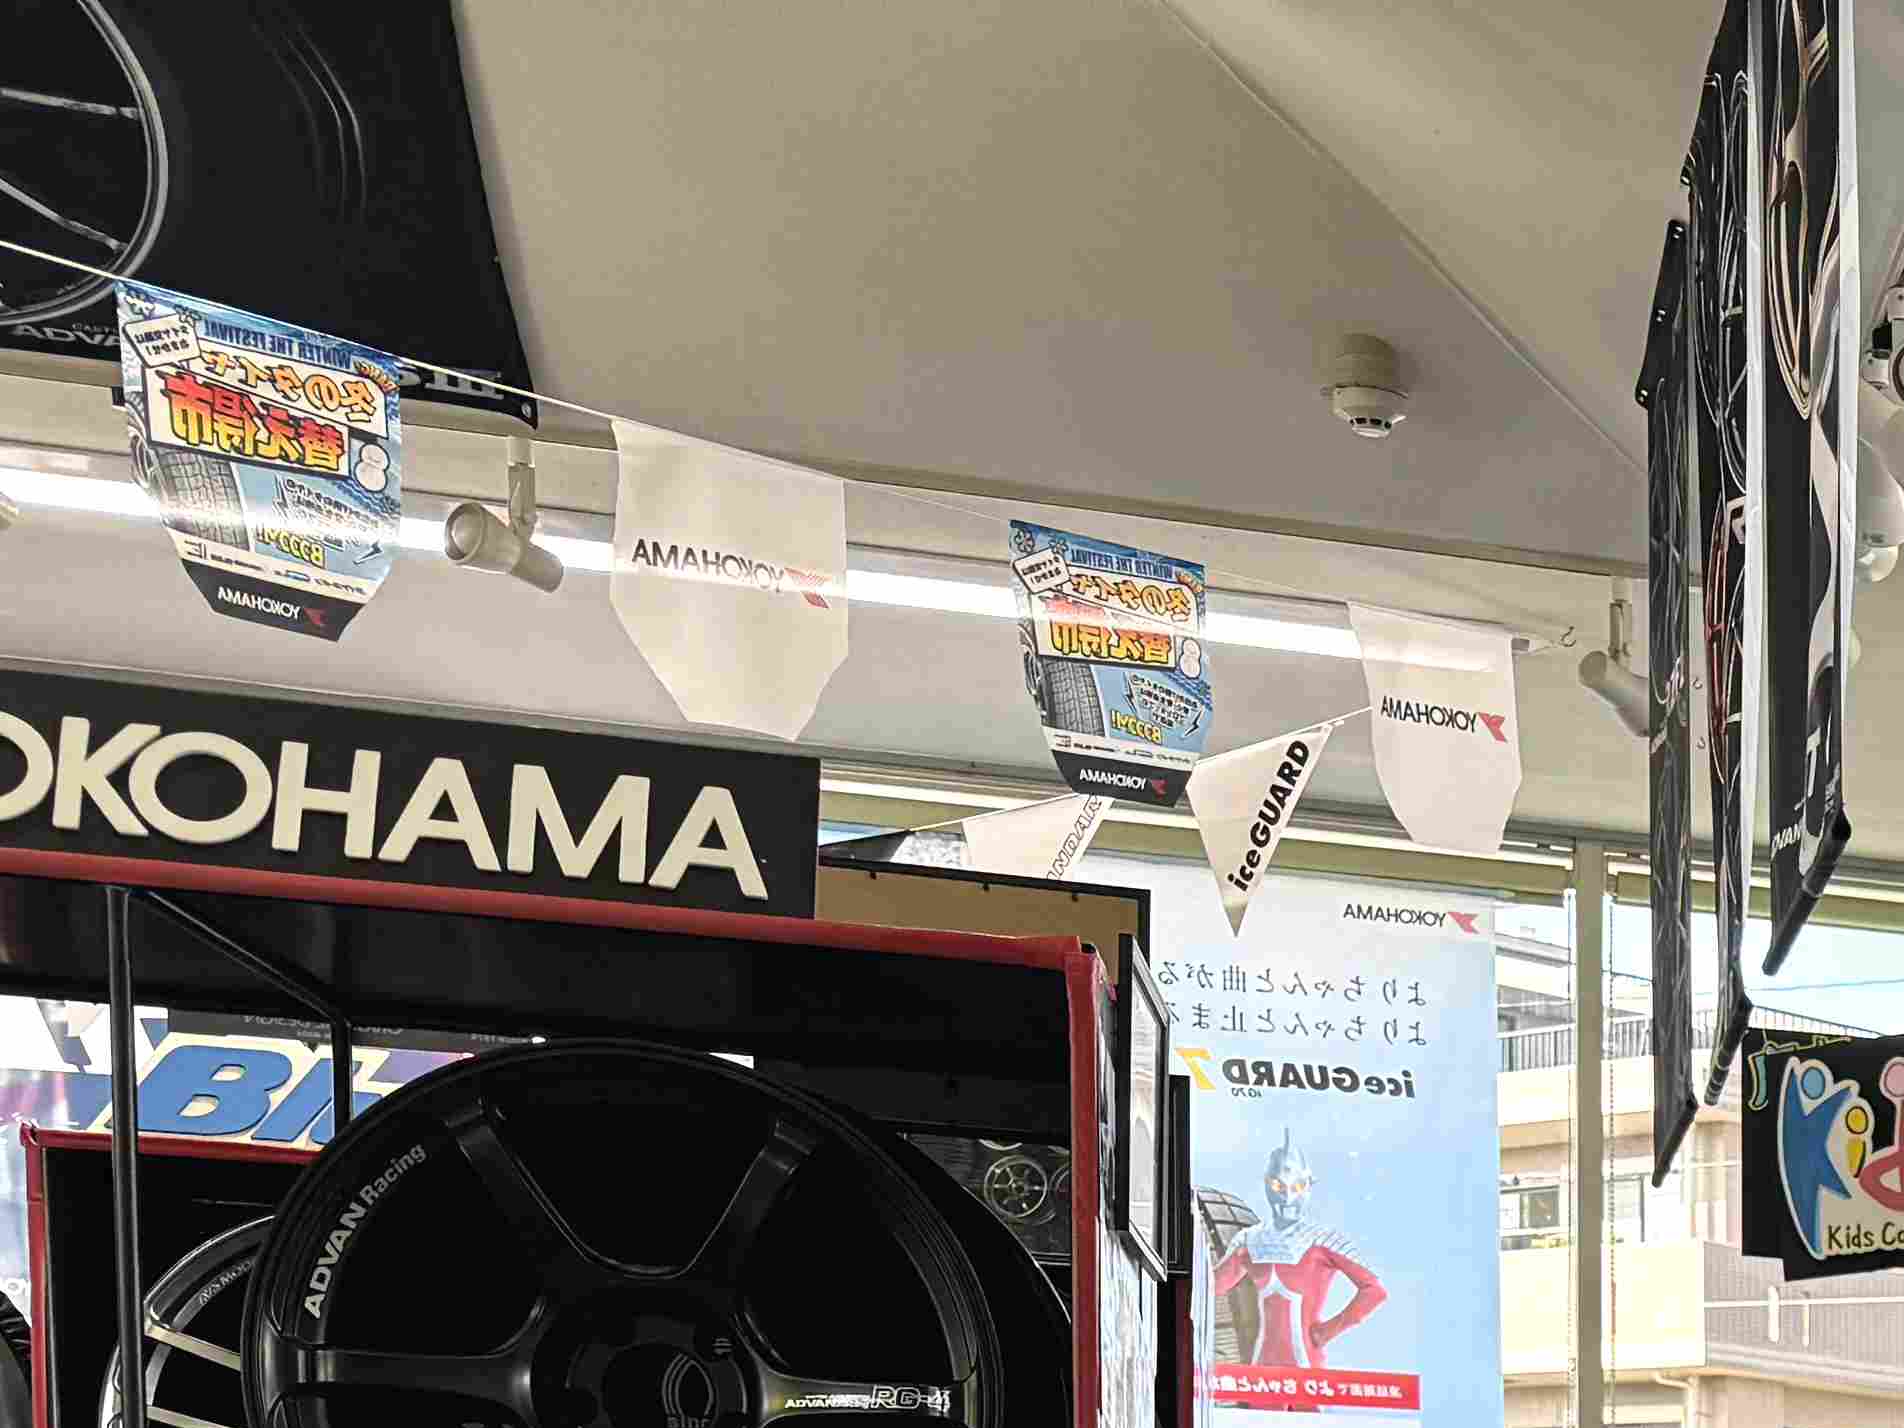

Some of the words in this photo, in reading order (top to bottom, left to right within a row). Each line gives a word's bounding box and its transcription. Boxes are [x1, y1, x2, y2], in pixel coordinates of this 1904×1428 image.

[11, 324, 120, 347] ADVA
[304, 1201, 367, 1320] ADVAN
[359, 1143, 428, 1206] Racing
[1826, 1219, 1875, 1250] Kids
